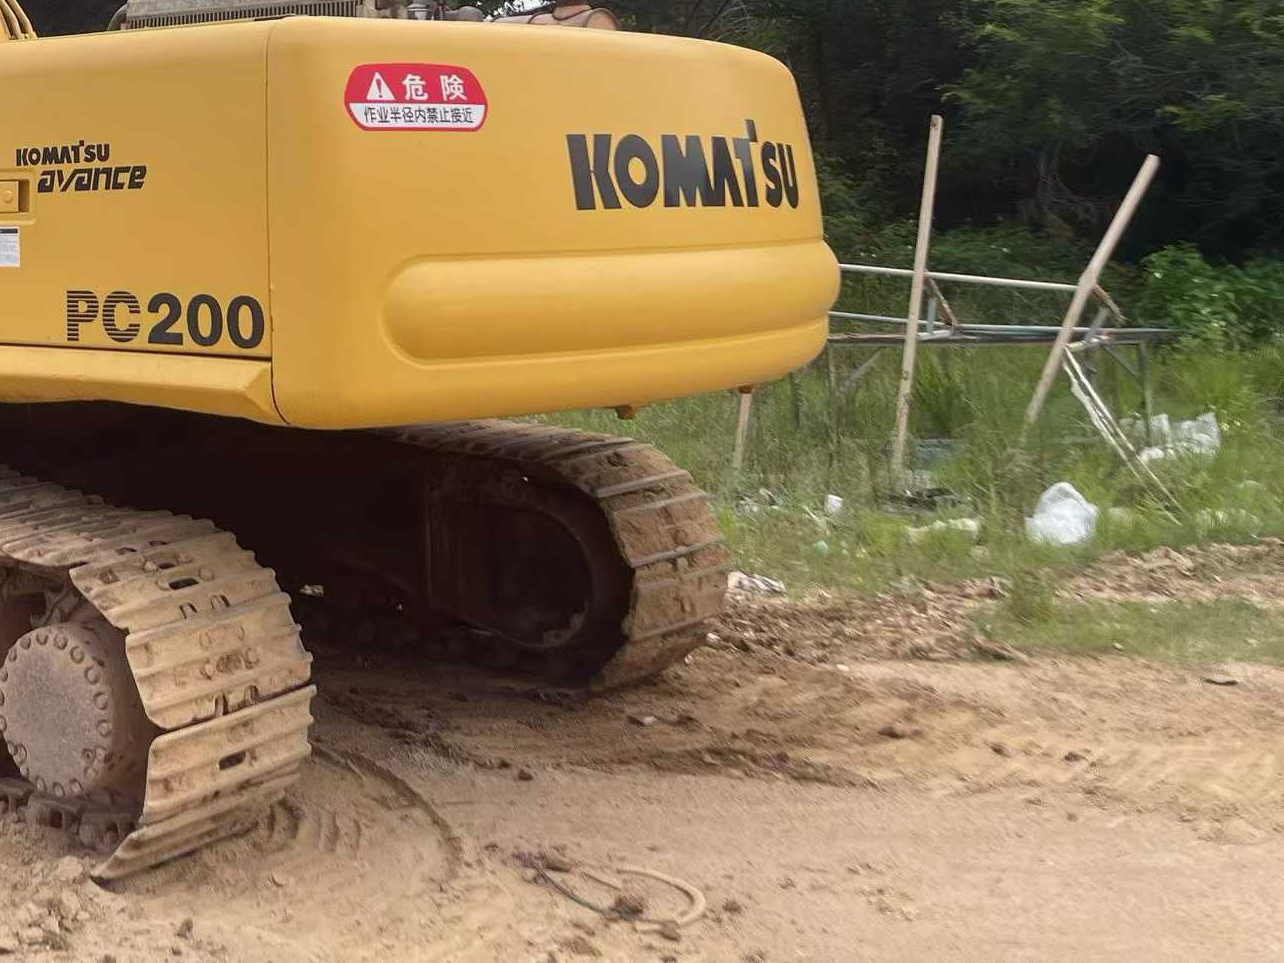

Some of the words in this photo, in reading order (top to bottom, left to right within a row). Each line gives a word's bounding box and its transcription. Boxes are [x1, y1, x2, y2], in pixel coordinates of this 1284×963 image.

[364, 105, 474, 124] 作业半径内禁止接近
[16, 139, 110, 167] KOMATSU
[566, 119, 800, 210] KOMATSU
[66, 289, 265, 350] PC200
